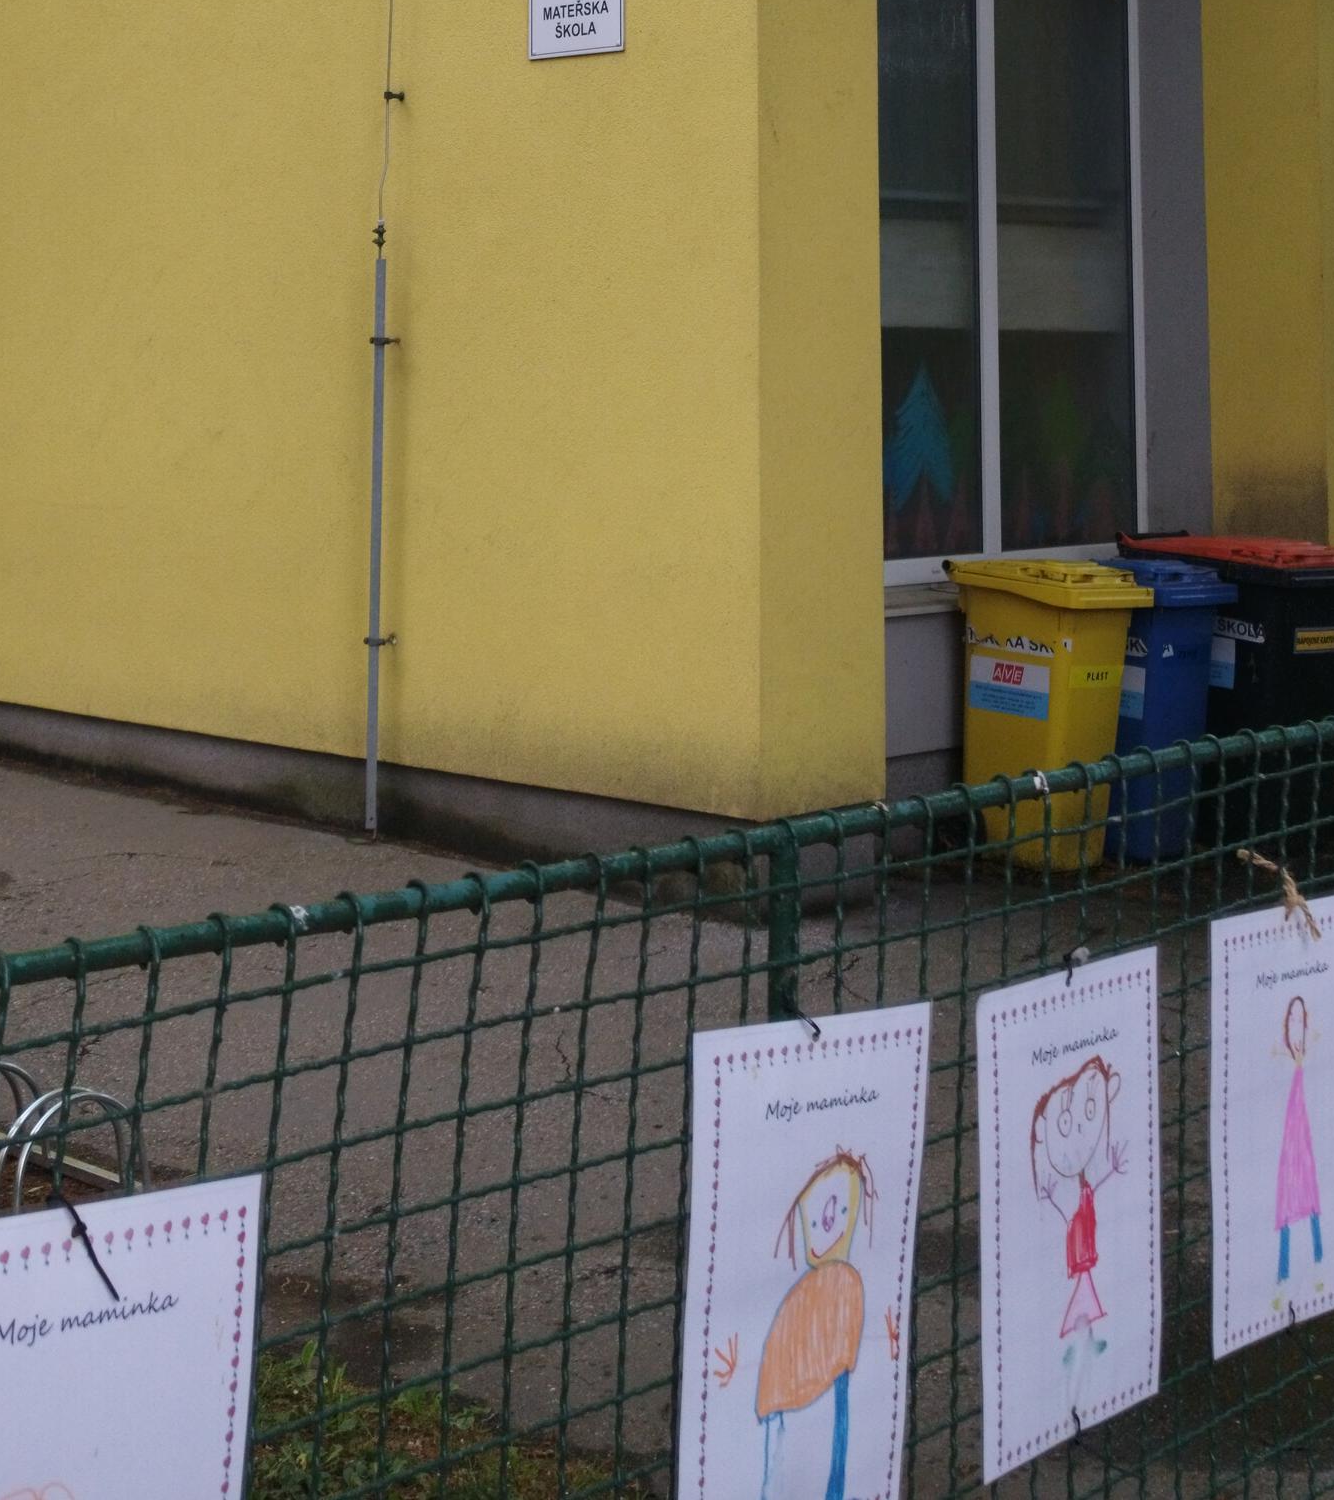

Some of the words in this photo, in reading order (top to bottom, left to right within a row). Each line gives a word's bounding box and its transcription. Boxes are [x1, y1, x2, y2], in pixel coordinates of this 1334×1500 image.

[555, 21, 597, 39] ŠKOLA
[993, 664, 1023, 683] AVE
[1087, 671, 1109, 681] PLAST
[1256, 970, 1277, 989] Moje
[1281, 960, 1329, 981] maminka
[1031, 1043, 1059, 1066] Moje
[1062, 1027, 1119, 1055] maminka
[765, 1097, 801, 1121] Moje
[804, 1086, 881, 1114] maminka
[60, 1290, 180, 1332] maminka
